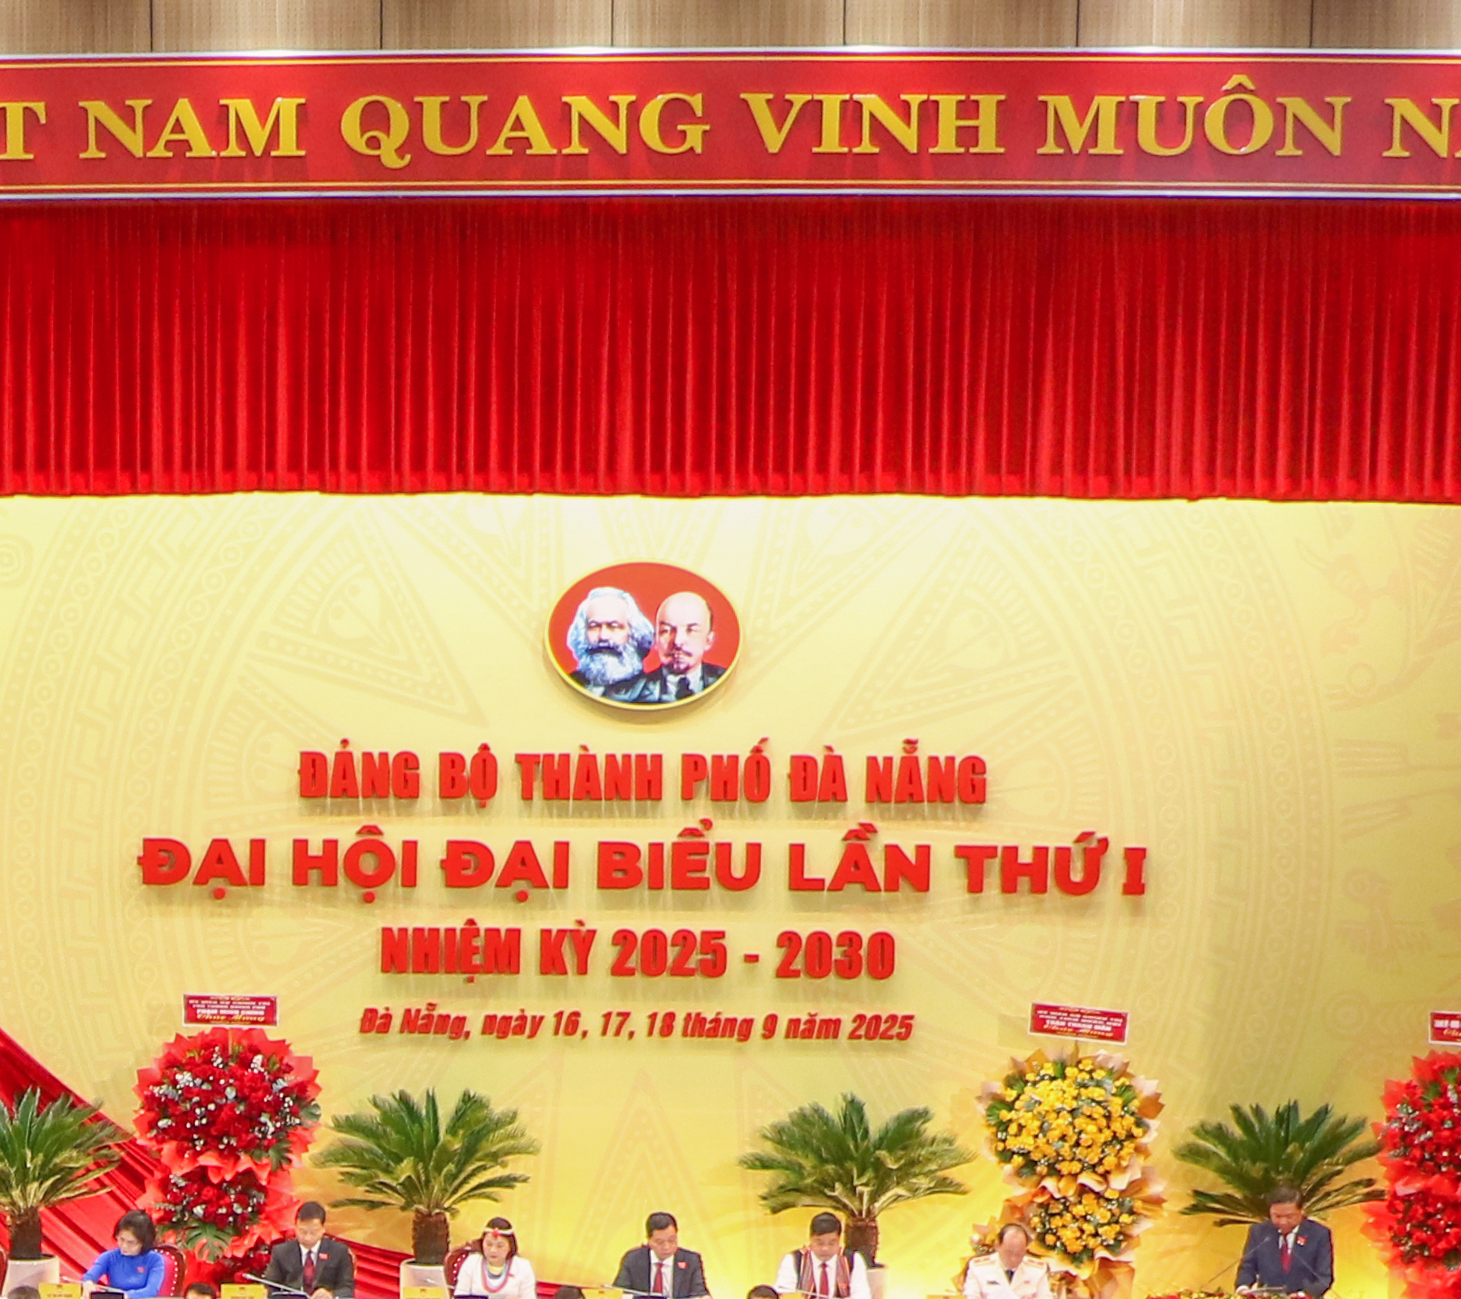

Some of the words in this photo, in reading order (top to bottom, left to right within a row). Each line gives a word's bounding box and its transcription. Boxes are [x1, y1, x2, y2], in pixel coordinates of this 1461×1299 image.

[79, 97, 306, 158] NAM
[341, 93, 710, 168] QUANG
[740, 93, 1005, 153] VINH
[1037, 74, 1352, 156] MUÔN
[299, 738, 421, 799] ĐẢNG
[439, 743, 498, 808] BỘ
[516, 745, 663, 801] THÀNH
[682, 738, 771, 803] PHỐ
[789, 746, 848, 802] ĐÀ
[866, 739, 987, 804] NẴNG
[138, 838, 266, 899] ĐẠI
[292, 825, 418, 903] HỘI
[441, 840, 570, 902] ĐẠI
[598, 818, 762, 891] BIỂU
[789, 822, 931, 892] LẦN
[955, 831, 1109, 896] THỨ
[1123, 847, 1147, 896] I
[381, 918, 522, 983] NHIỆM
[540, 919, 597, 975] KỲ
[611, 928, 727, 978] 2025
[776, 930, 896, 979] 2030
[360, 1007, 392, 1034] Đà
[400, 1003, 471, 1040] Nẵng,
[481, 1009, 544, 1039] ngày
[649, 1011, 676, 1037] 18
[682, 1011, 754, 1041] tháng
[763, 1014, 778, 1039] 9
[786, 1013, 842, 1039] năm
[849, 1013, 914, 1040] 2025
